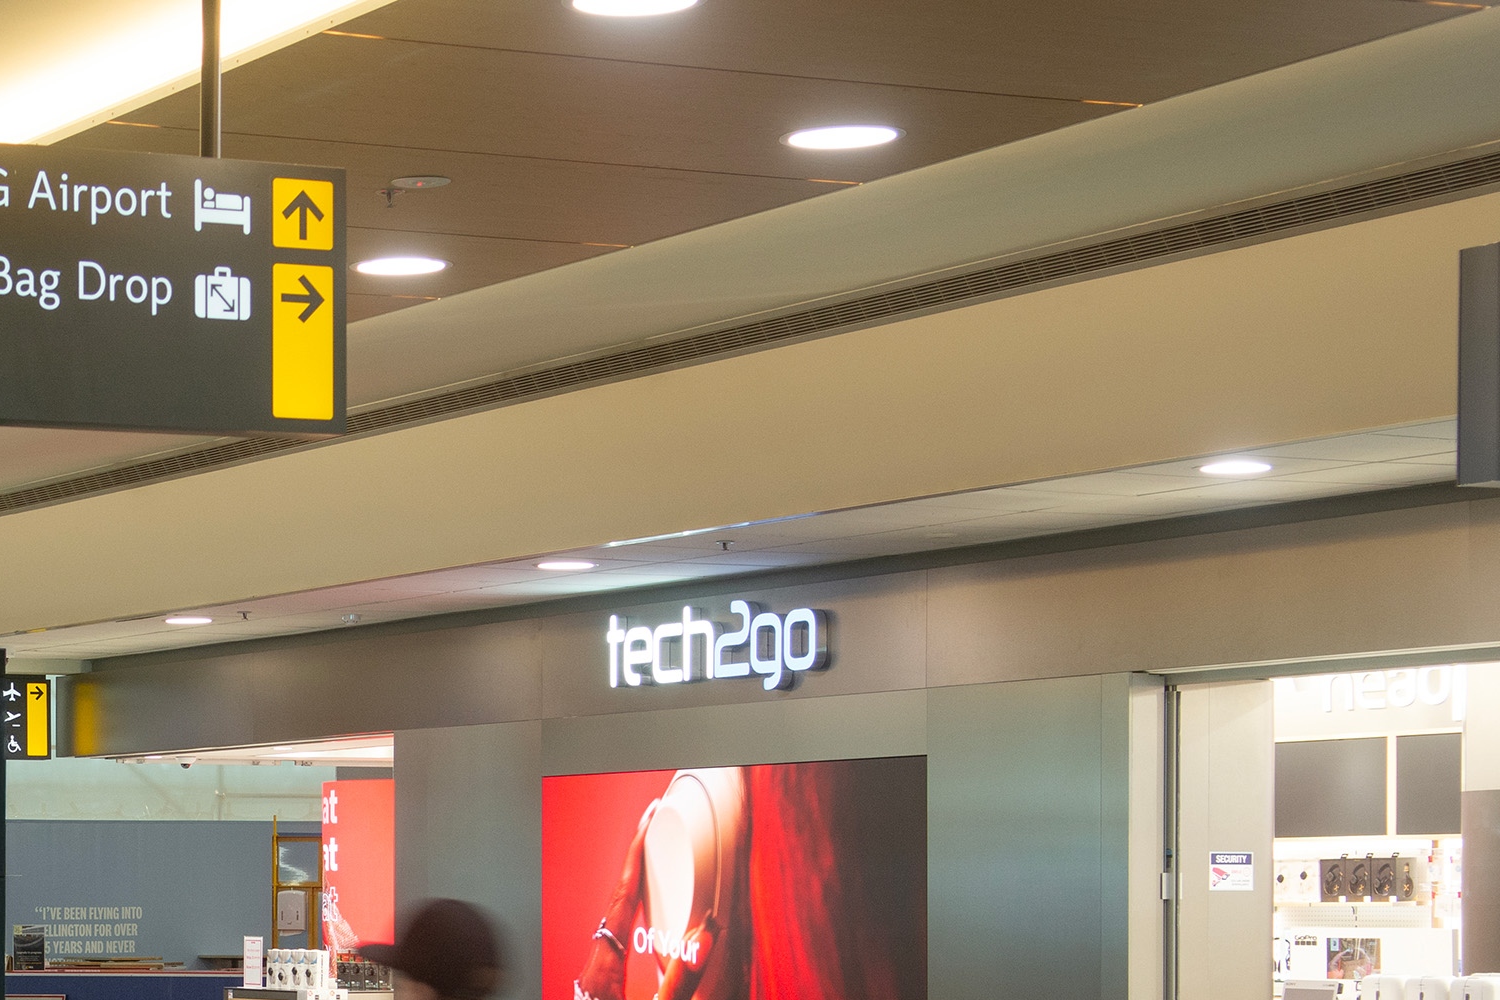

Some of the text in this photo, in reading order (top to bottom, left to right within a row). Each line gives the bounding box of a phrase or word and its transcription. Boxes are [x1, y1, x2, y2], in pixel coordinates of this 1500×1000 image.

[28, 171, 171, 225] Airport
[78, 261, 172, 316] Drop
[606, 600, 816, 691] tech2go
[1215, 854, 1247, 864] SECURITY
[63, 907, 87, 920] BEEN
[89, 906, 120, 920] FLYING
[121, 906, 143, 920] INTO
[44, 923, 138, 937] ELLINGTON FOR OVER
[44, 940, 136, 954] 5 YEARS AND NEVER
[633, 926, 700, 964] Of Your
